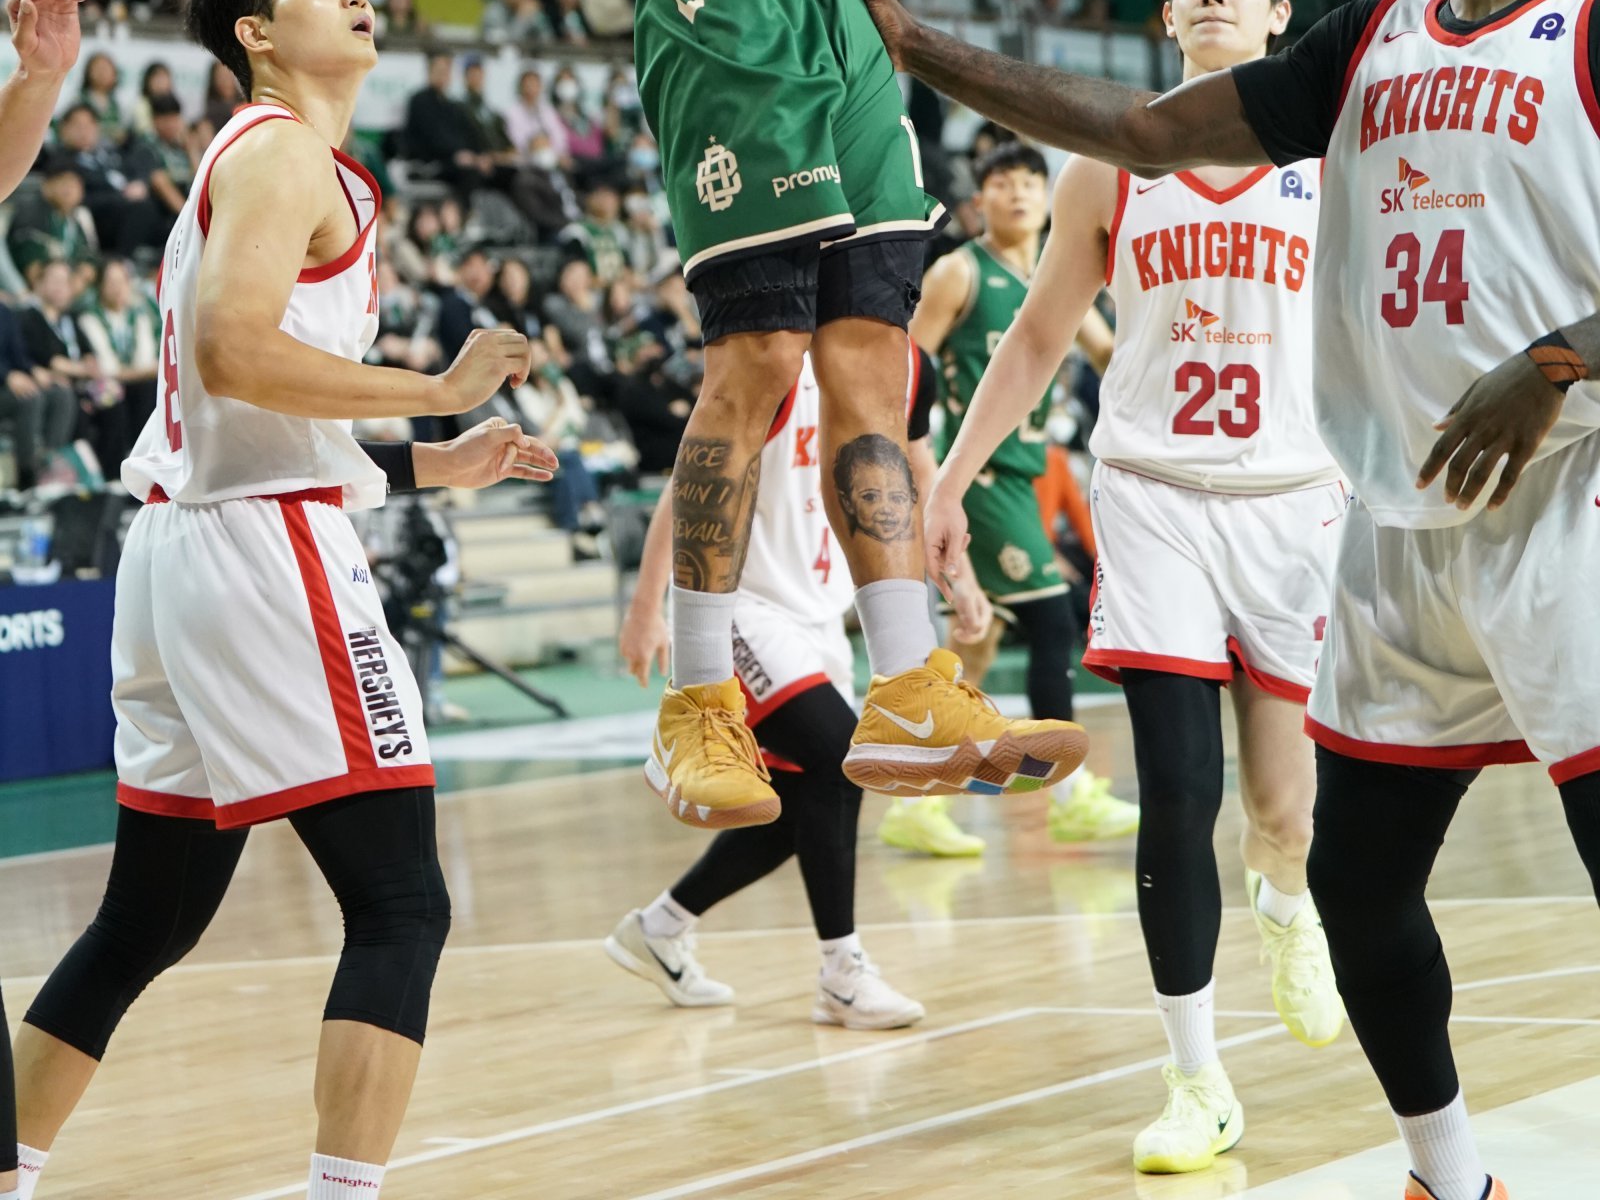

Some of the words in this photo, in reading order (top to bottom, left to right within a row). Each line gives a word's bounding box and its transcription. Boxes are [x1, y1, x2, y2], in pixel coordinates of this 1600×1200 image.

[1360, 65, 1545, 153] KNIGHTS
[772, 164, 842, 198] promy
[1380, 187, 1405, 213] SK
[1412, 189, 1485, 210] telecom
[1131, 221, 1310, 293] KNIGHTS
[1381, 229, 1469, 328] 34
[1170, 322, 1197, 343] SK
[1205, 327, 1272, 345] telecom
[1172, 361, 1261, 439] 23
[348, 629, 413, 760] HERSHEY'S
[322, 1172, 379, 1188] knights
